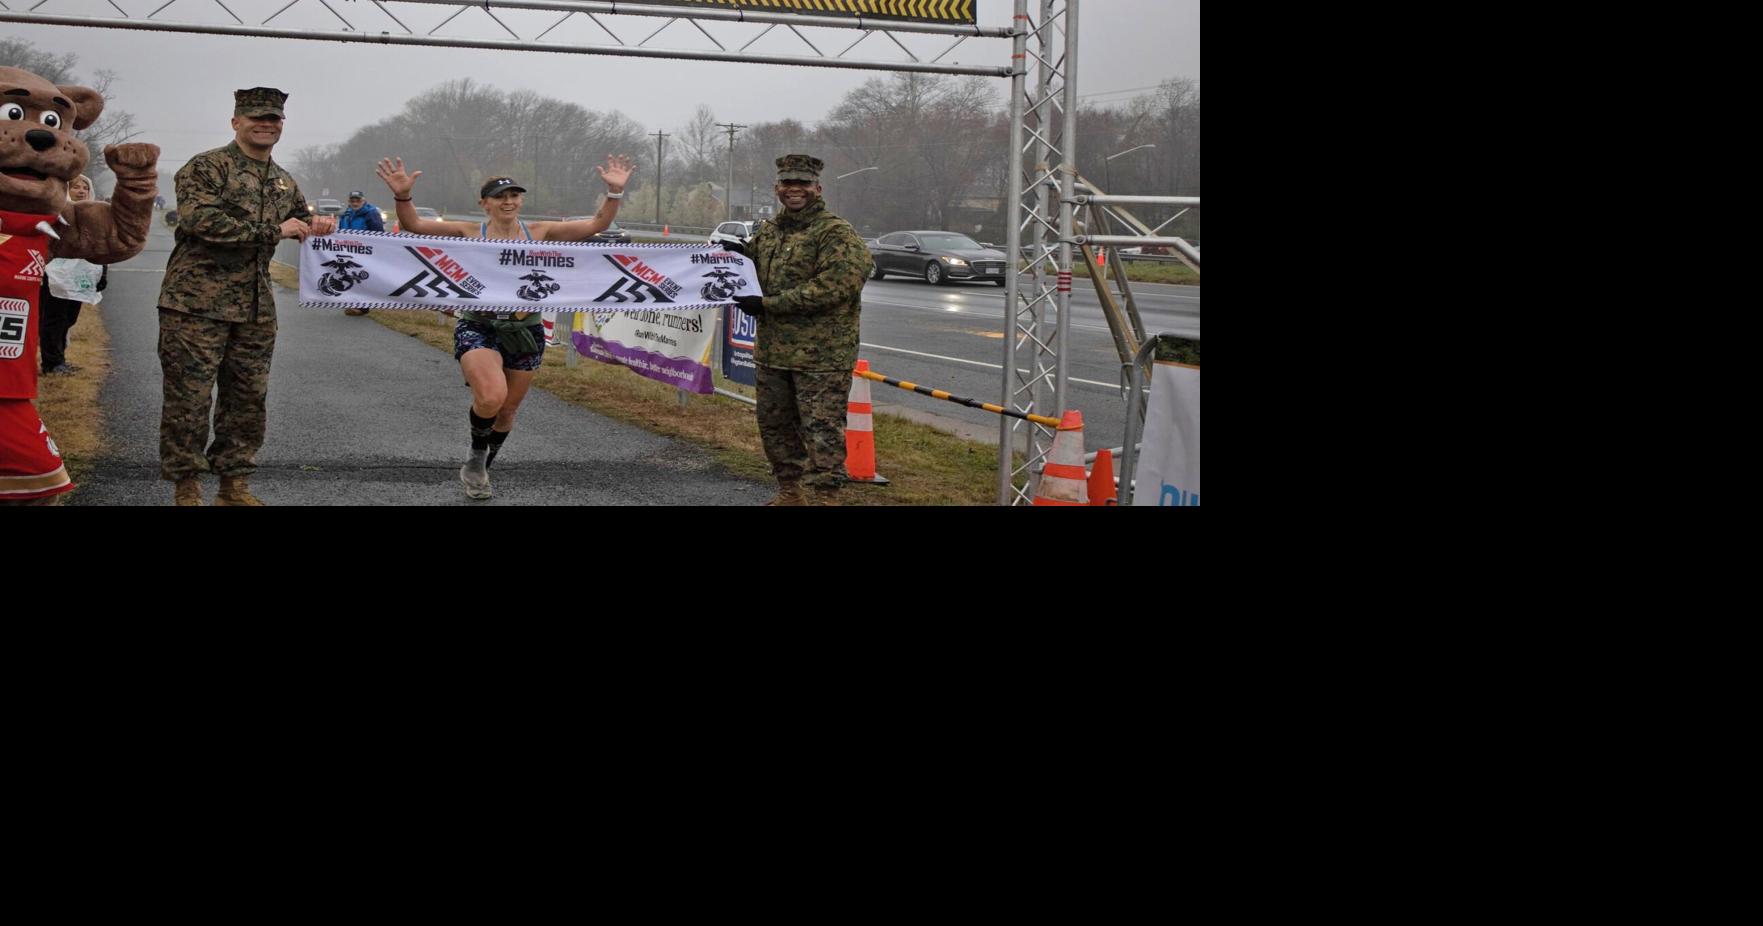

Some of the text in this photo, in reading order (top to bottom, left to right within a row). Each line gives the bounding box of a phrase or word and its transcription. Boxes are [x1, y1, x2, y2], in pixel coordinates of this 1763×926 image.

[312, 238, 373, 255] #Marines
[499, 249, 575, 268] #Marines
[435, 254, 469, 283] MCM
[631, 261, 666, 284] MCM
[459, 280, 481, 296] SERIES
[465, 275, 486, 291] EVENT
[658, 282, 678, 299] SERIES
[663, 277, 683, 292] EVENT
[0, 316, 24, 341] 5
[662, 313, 703, 333] runners!
[734, 306, 757, 338] USO
